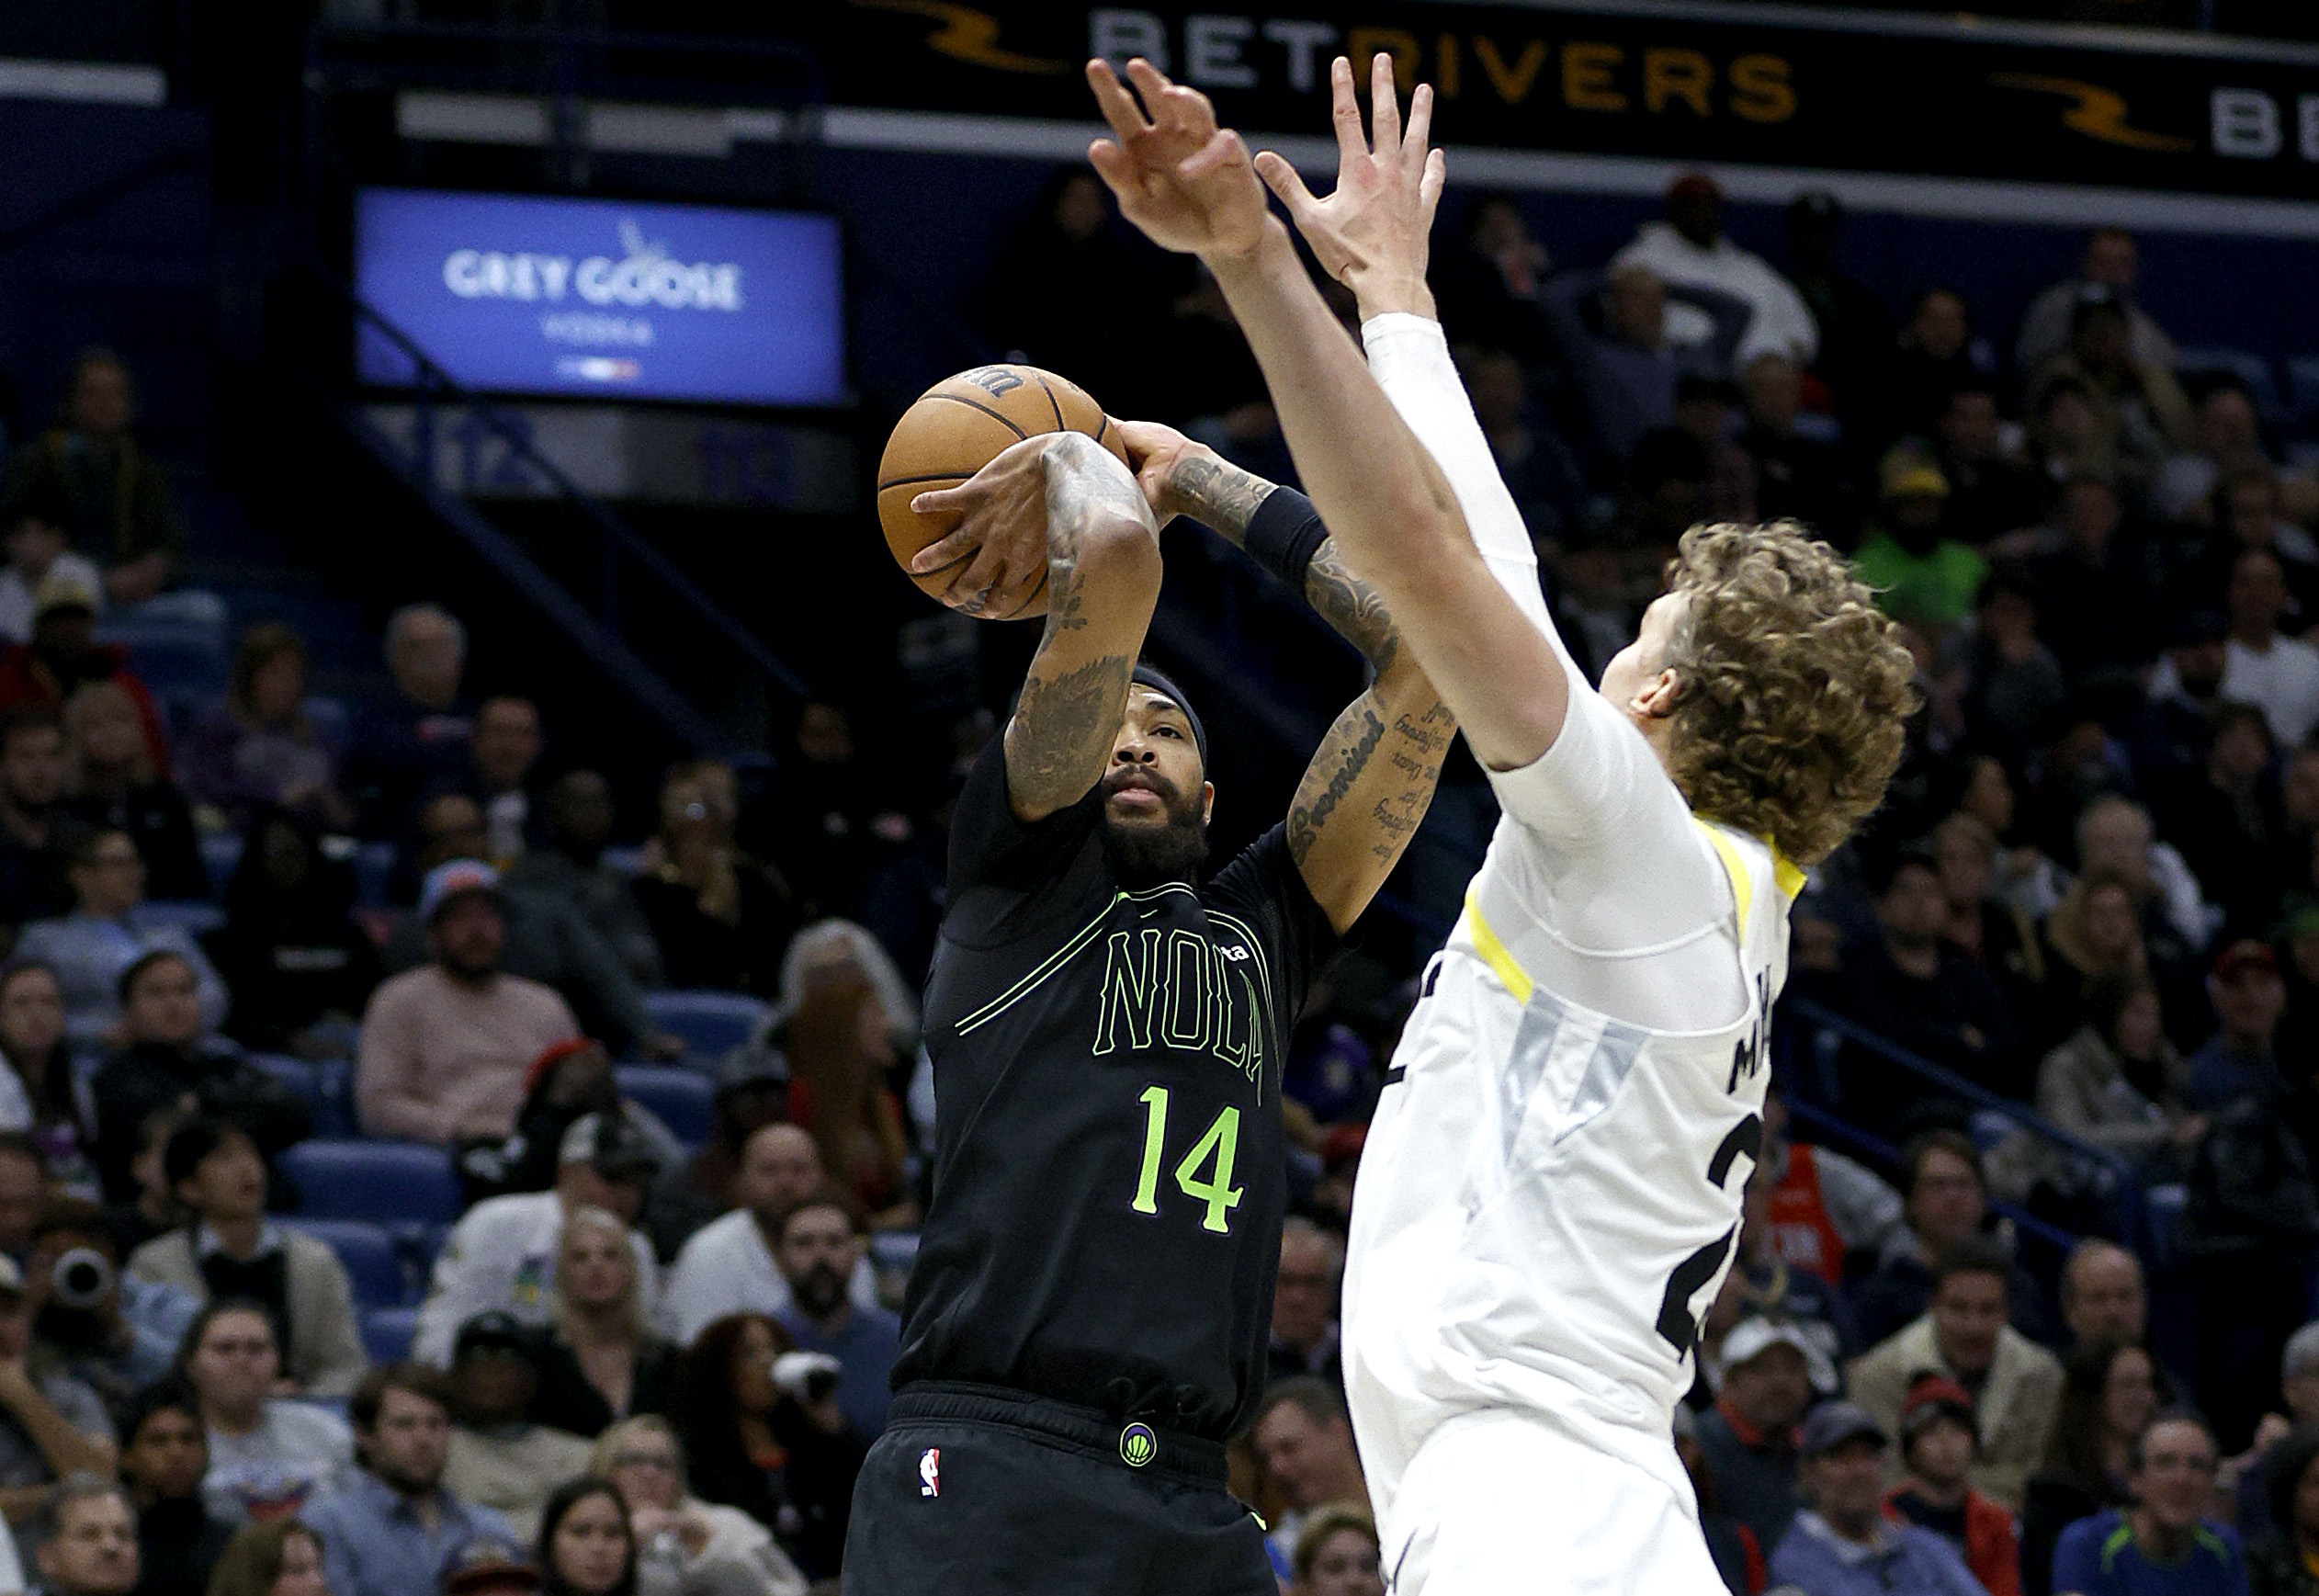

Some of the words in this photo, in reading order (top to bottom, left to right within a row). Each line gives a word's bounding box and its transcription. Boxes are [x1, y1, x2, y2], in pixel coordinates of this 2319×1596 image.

[443, 248, 571, 300] GREY
[574, 255, 746, 311] GOOSE
[1131, 1085, 1244, 1234] 14
